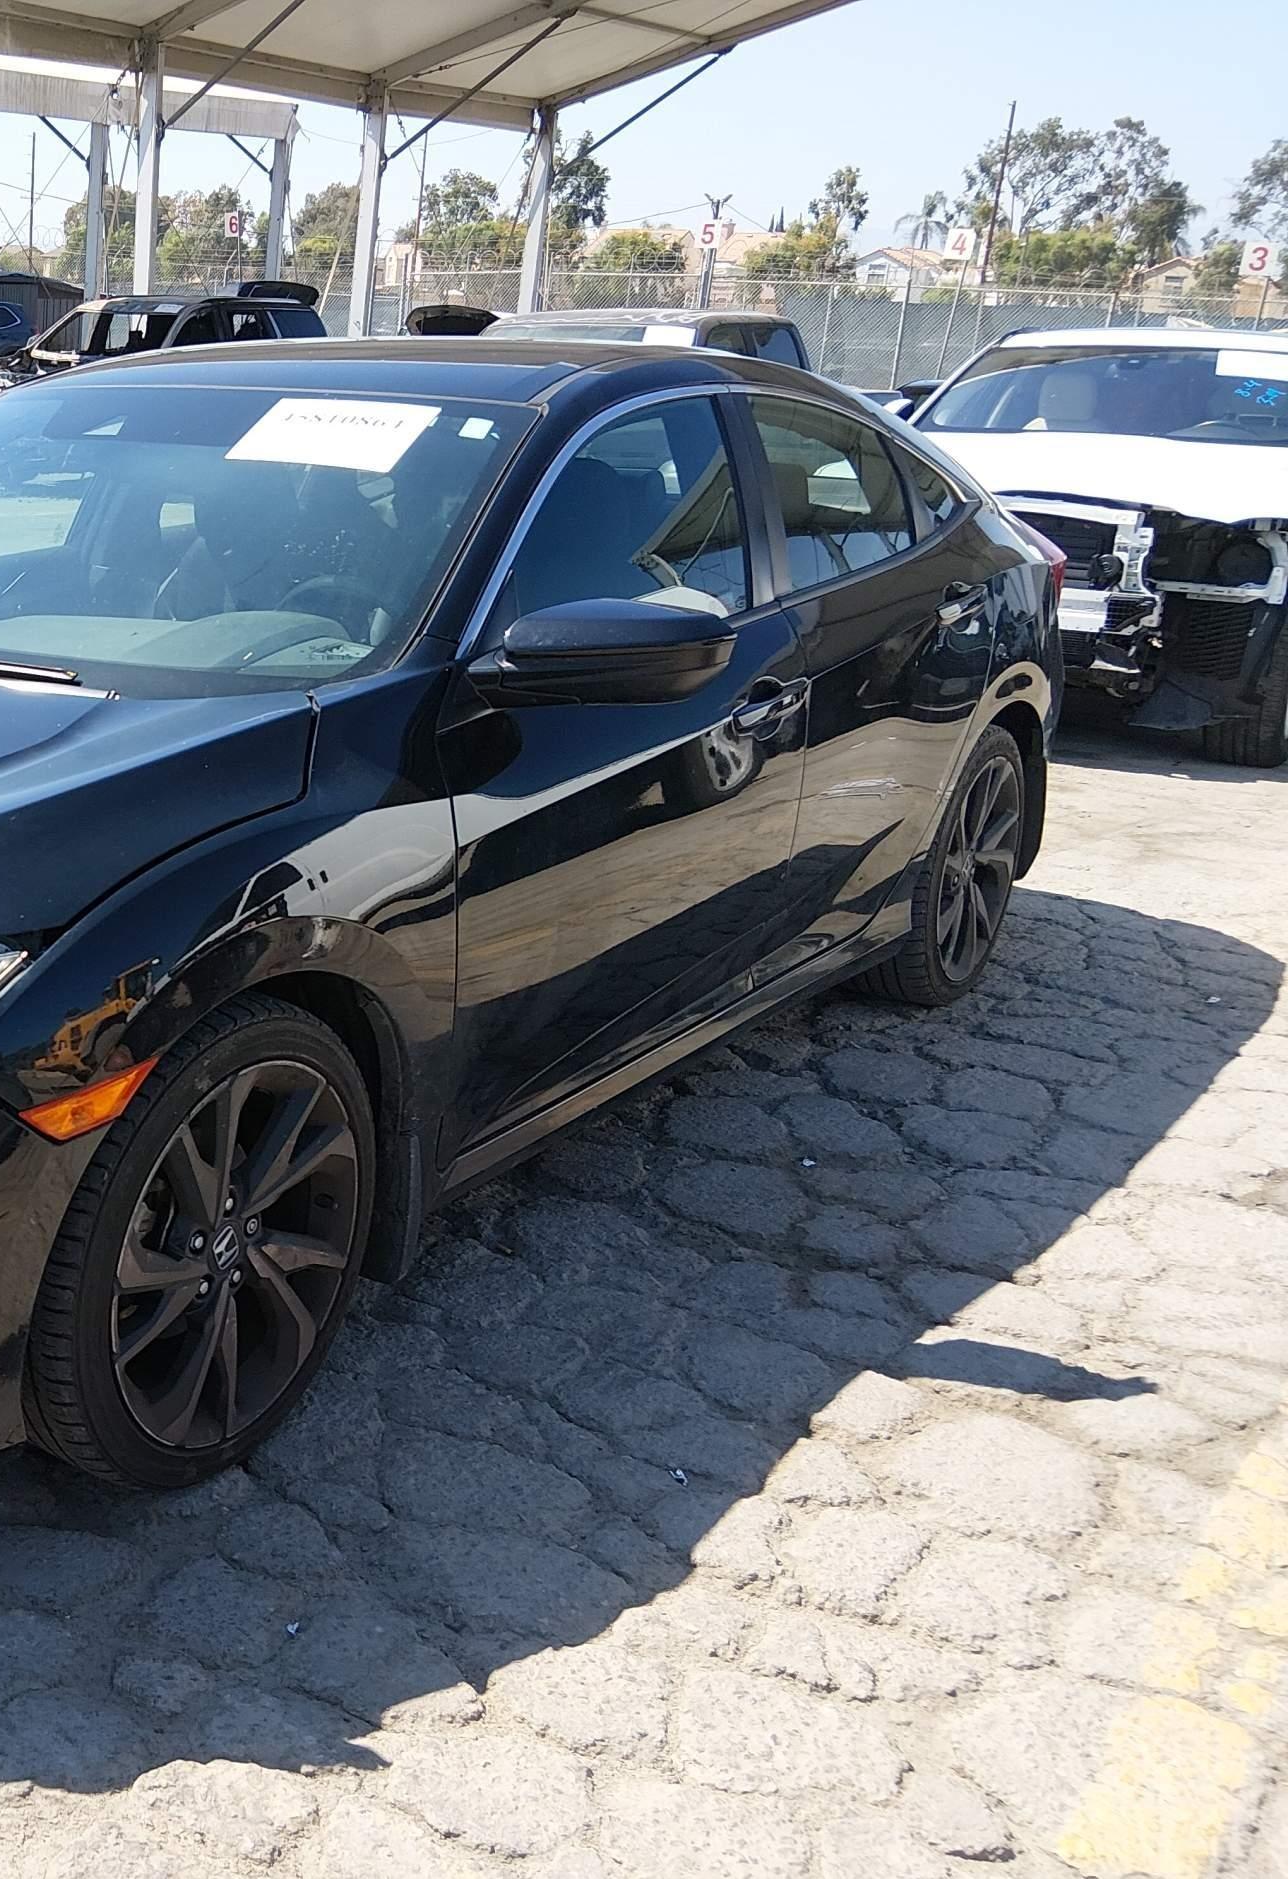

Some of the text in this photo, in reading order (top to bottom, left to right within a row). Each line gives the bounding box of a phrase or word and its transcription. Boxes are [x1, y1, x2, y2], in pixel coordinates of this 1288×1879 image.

[229, 216, 238, 233] 6
[702, 224, 715, 244] 5
[952, 233, 967, 255] 4
[1249, 247, 1269, 271] 3
